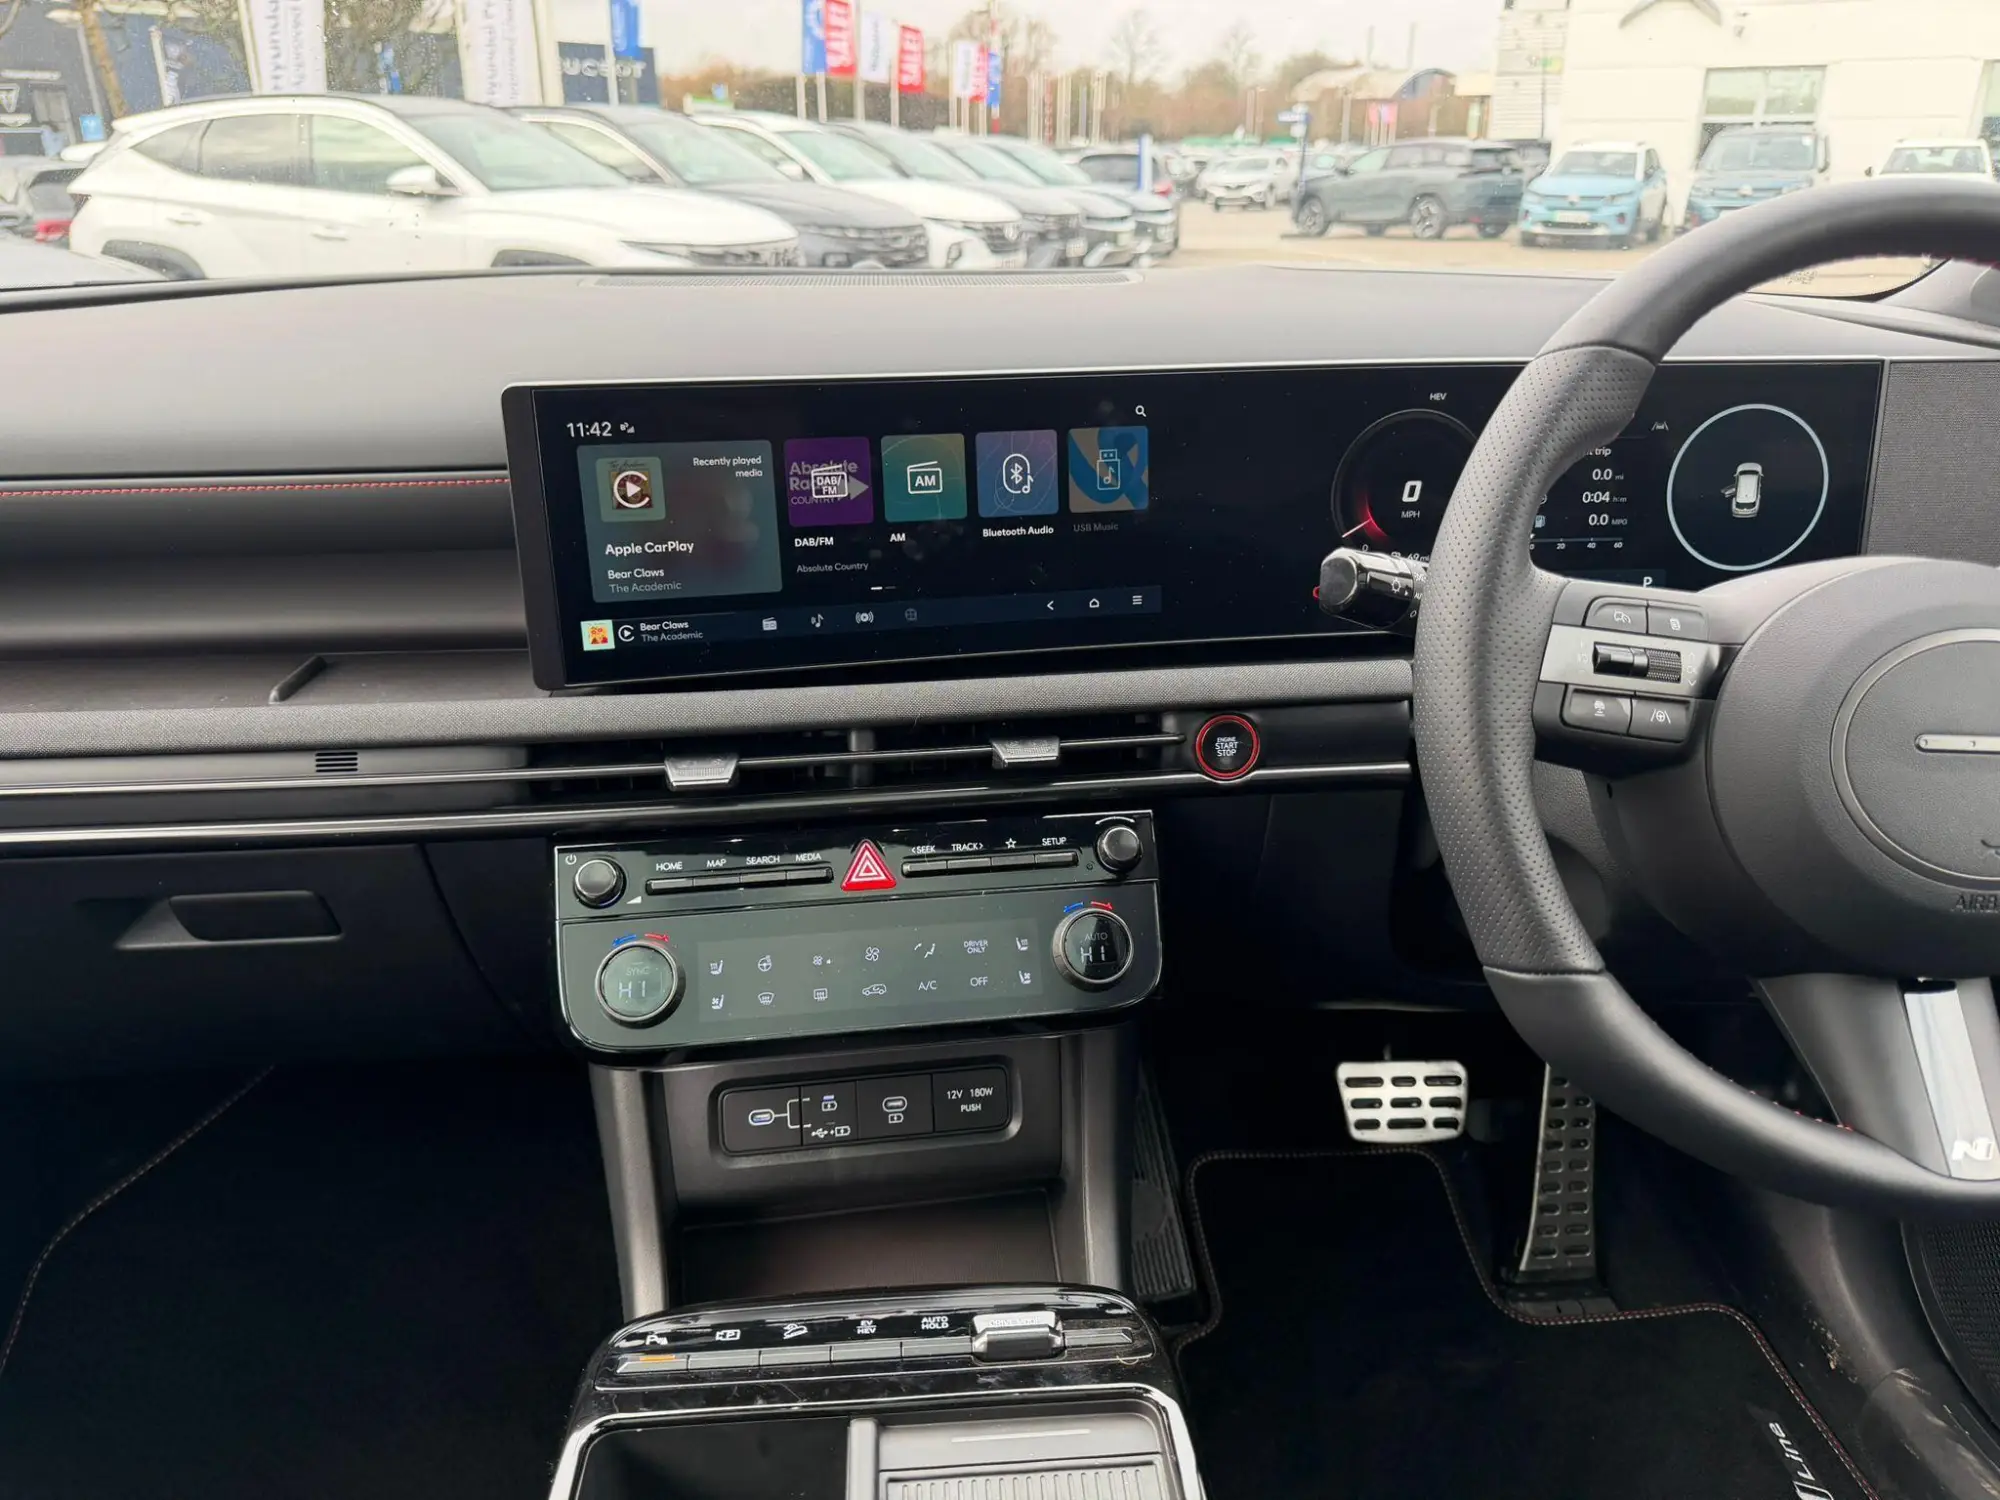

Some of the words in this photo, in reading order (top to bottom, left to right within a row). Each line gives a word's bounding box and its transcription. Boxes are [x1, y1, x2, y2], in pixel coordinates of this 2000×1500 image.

[1430, 393, 1446, 401] HEV
[566, 421, 613, 438] 11:42
[1595, 447, 1611, 457] trip
[693, 457, 730, 467] Recently
[732, 456, 762, 468] played
[735, 469, 763, 478] media
[1592, 468, 1612, 481] 0.0
[915, 475, 936, 486] AM
[822, 486, 837, 495] FM
[1402, 480, 1422, 503] 0
[1582, 491, 1610, 503] 0:04
[1401, 511, 1420, 519] MPH
[1588, 514, 1609, 526] 0.0
[982, 527, 1026, 537] Bluetooth
[1028, 525, 1054, 535] Audio
[1073, 523, 1091, 532] USB
[1094, 522, 1119, 531] Music
[794, 536, 834, 547] DAB/FM
[890, 532, 906, 543] AM
[605, 542, 643, 557] Apple
[645, 541, 694, 555] CarPlay
[608, 569, 631, 579] Bear
[633, 567, 664, 578] Claws
[797, 563, 833, 573] Absolute
[835, 562, 869, 573] Country
[609, 584, 629, 594] The
[632, 580, 682, 591] Academic
[1643, 577, 1653, 587] P
[640, 622, 661, 631] Bear
[663, 620, 689, 630] Claws
[641, 633, 660, 643] The
[661, 631, 703, 642] Academic
[1215, 742, 1238, 750] START
[1217, 749, 1236, 757] STOP
[1042, 837, 1067, 846] SETUP
[656, 862, 683, 872] HOME
[706, 858, 727, 868] MAP
[746, 855, 780, 865] SEARCH
[795, 852, 822, 862] MEDIA
[1084, 932, 1108, 941] AUTO
[964, 939, 988, 948] DRIVER
[967, 946, 986, 954] ONLY
[1080, 946, 1106, 963] HI
[626, 966, 650, 976] SYNC
[918, 980, 937, 990] A/C
[970, 976, 988, 986] OFF
[618, 980, 647, 1000] HI
[947, 1090, 963, 1099] 12V
[970, 1087, 993, 1098] 180W
[960, 1103, 981, 1112] PUSH
[860, 1319, 874, 1327] EV
[921, 1315, 948, 1324] AUTO
[857, 1327, 876, 1335] HEV
[921, 1322, 949, 1330] HOLD
